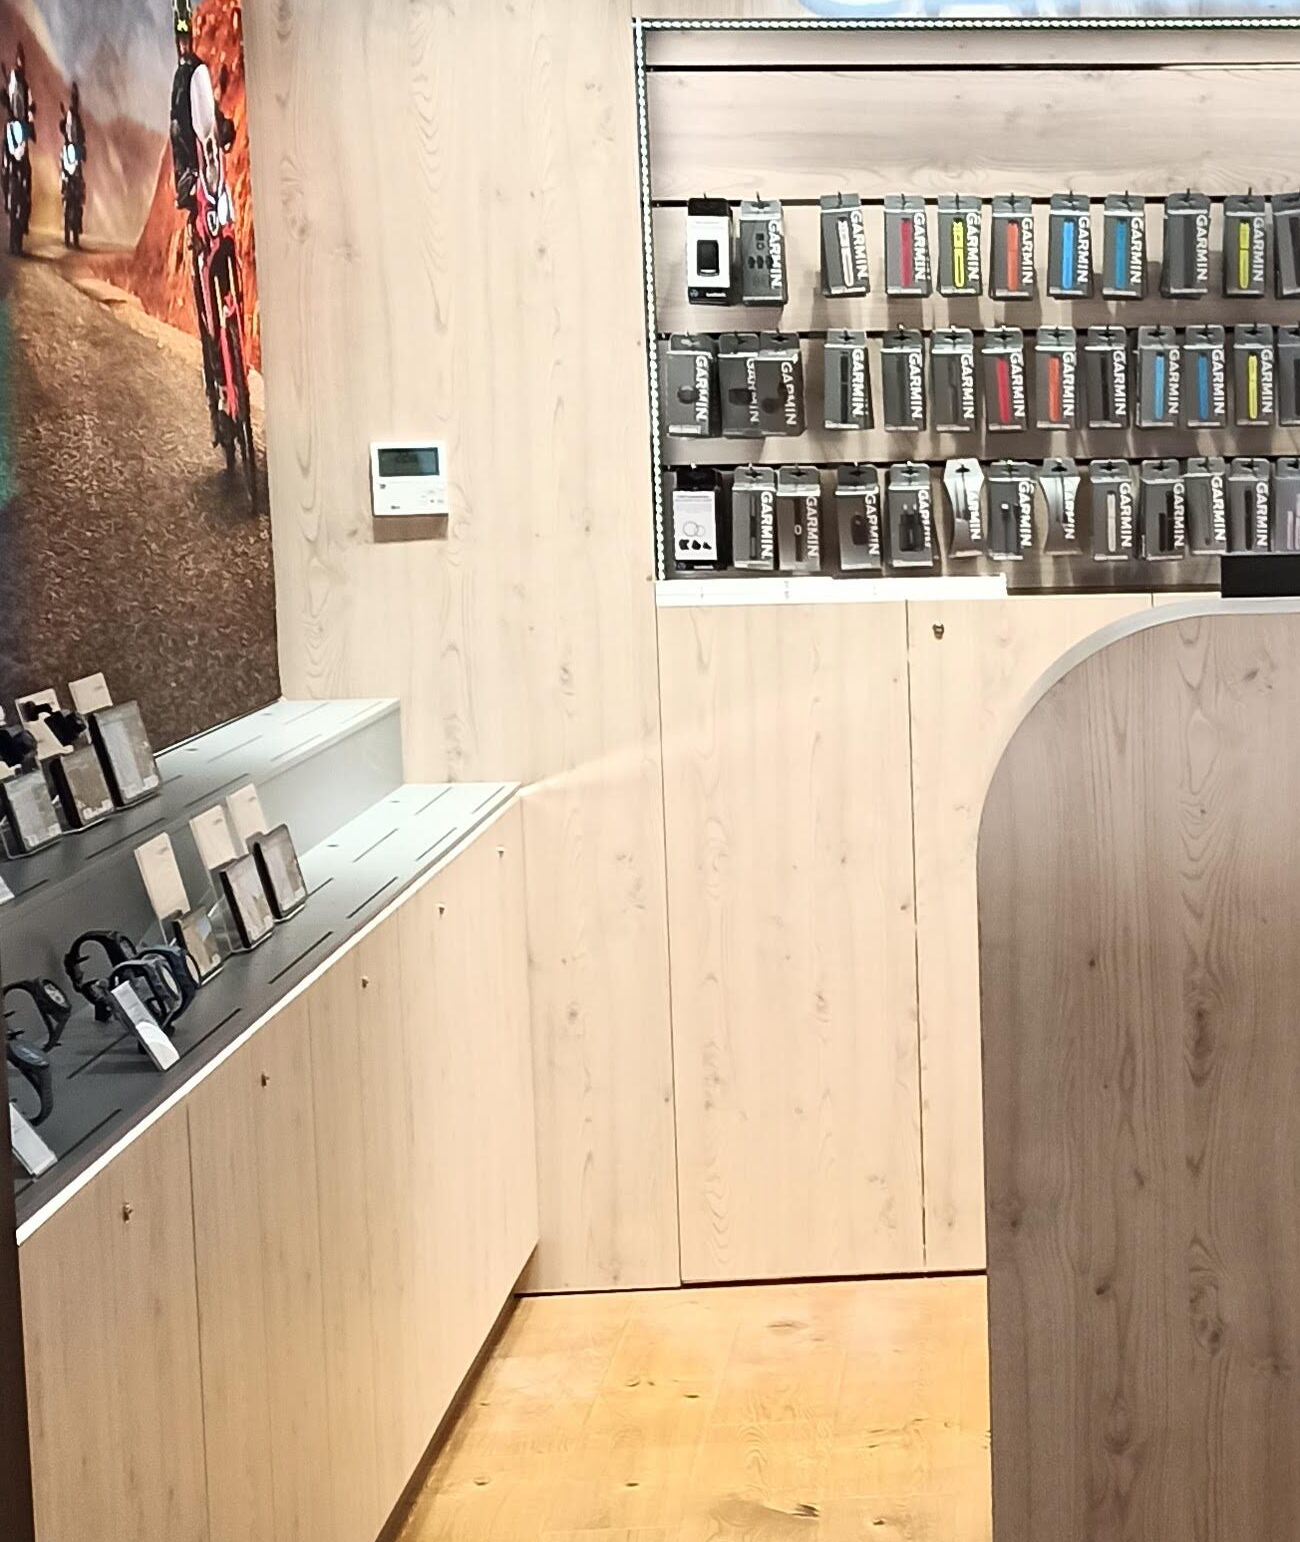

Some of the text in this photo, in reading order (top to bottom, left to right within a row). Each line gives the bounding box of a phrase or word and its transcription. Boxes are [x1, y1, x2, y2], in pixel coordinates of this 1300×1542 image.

[768, 219, 784, 290] GARMIN
[850, 211, 868, 280] GARMIN
[914, 212, 927, 282] GARMIN
[966, 213, 980, 280] GARMIN
[1021, 218, 1033, 284] GARMIN
[1078, 217, 1090, 283] GARMIN
[1130, 217, 1143, 284] GARMIN
[1196, 215, 1208, 281] GARMIN
[1253, 217, 1264, 282] GARMIN
[696, 355, 709, 421] GARMIN
[851, 349, 864, 417] GARMIN
[909, 353, 922, 419] GARMIN
[960, 353, 974, 419] GARMIN
[1010, 353, 1026, 417] GARMIN
[1062, 351, 1076, 417] GARMIN
[1113, 350, 1126, 415] GARMIN
[1168, 349, 1180, 414] GARMIN
[1212, 349, 1224, 414] GARMIN
[1261, 349, 1273, 413] GARMIN
[760, 492, 773, 559] GARMIN
[806, 496, 818, 558] GARMIN
[865, 492, 880, 556] GARMIN
[1018, 481, 1032, 547] GARMIN
[1120, 483, 1132, 547] GARMIN
[1173, 483, 1184, 547] GARMIN
[1211, 476, 1226, 541] GARMIN
[1256, 482, 1268, 547] GARMIN
